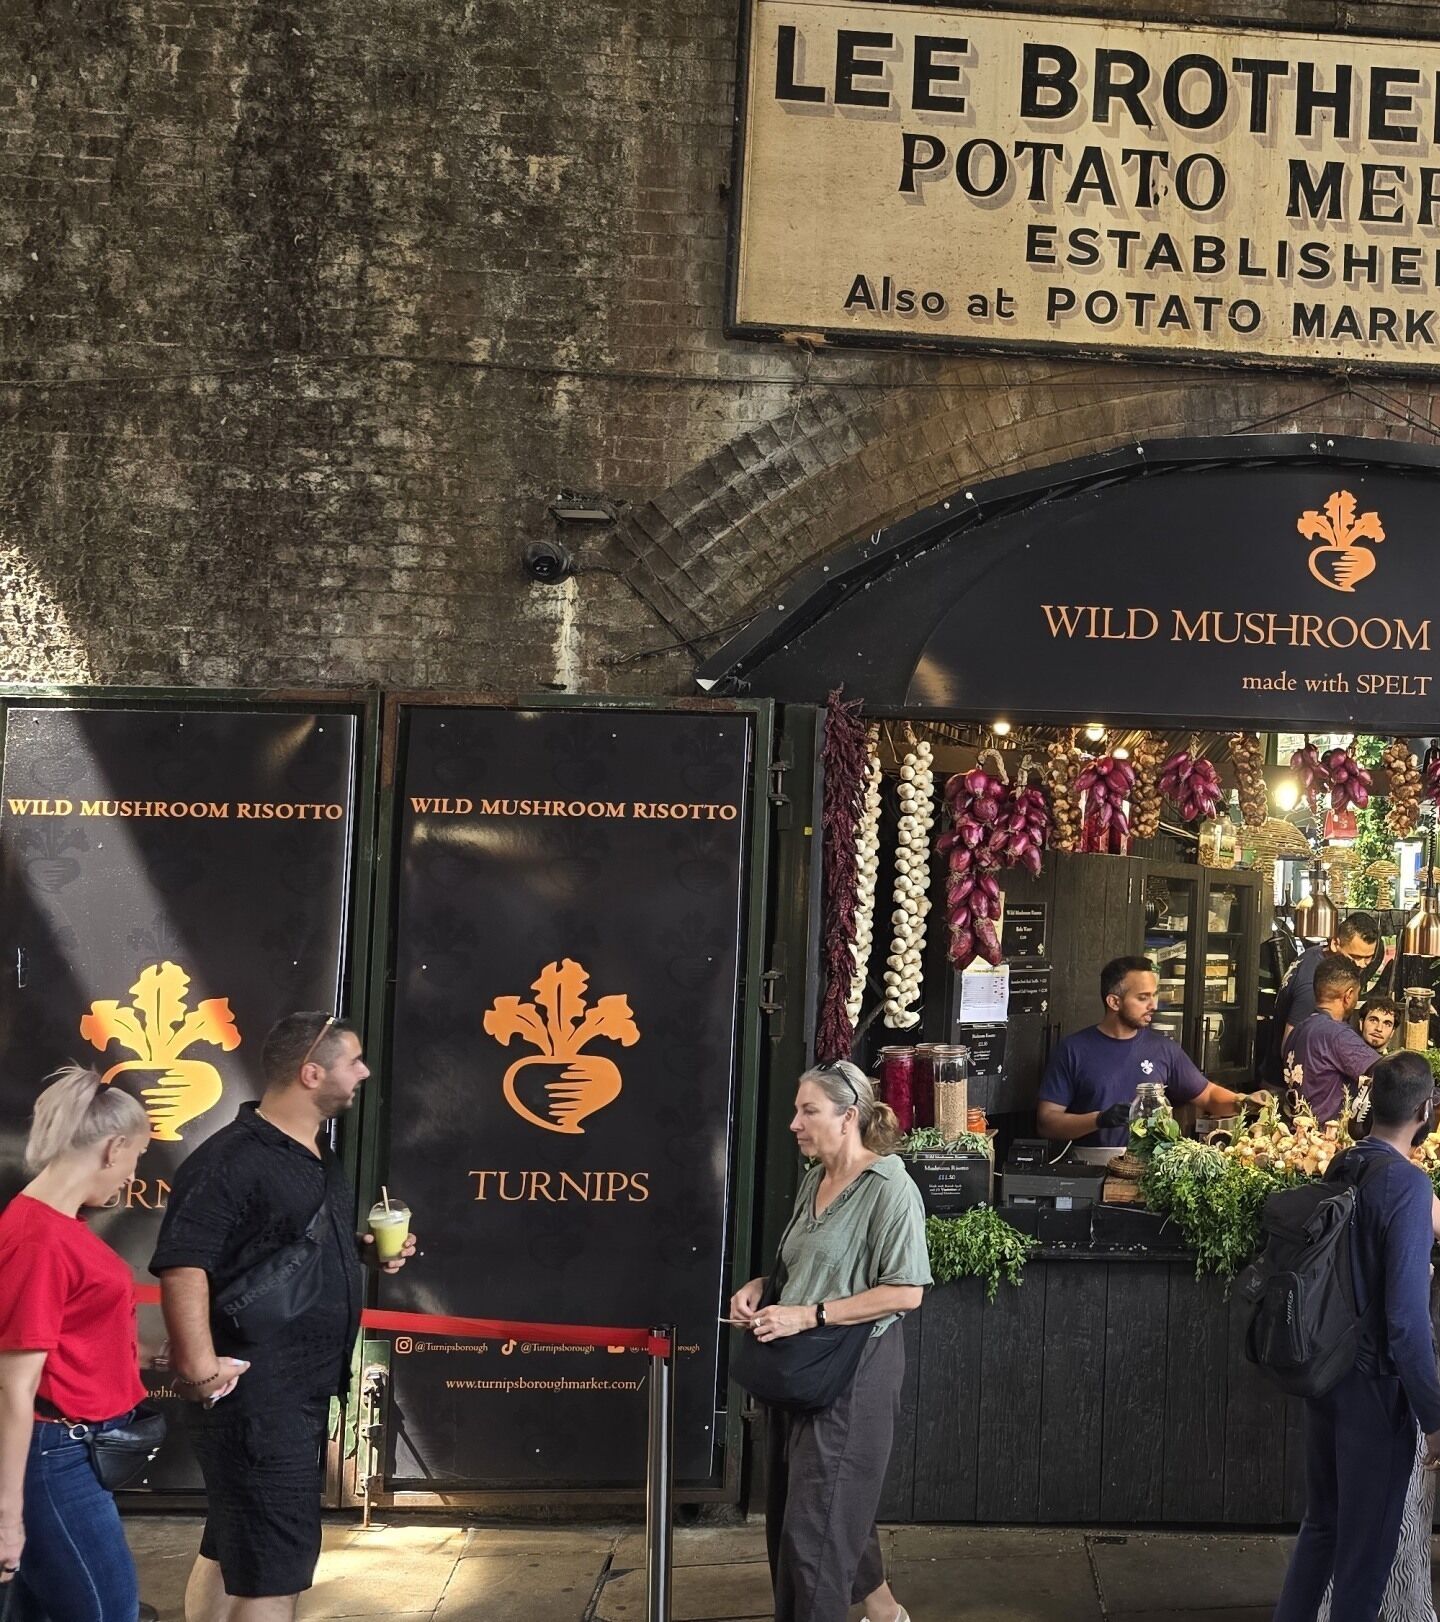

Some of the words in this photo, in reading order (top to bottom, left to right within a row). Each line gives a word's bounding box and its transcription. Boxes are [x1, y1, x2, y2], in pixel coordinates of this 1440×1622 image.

[775, 25, 968, 113] LEE
[899, 133, 1226, 211] POTATO
[844, 274, 945, 314] Also
[968, 288, 1014, 318] at
[1047, 287, 1261, 333] POTATO
[1041, 605, 1159, 641] WILD
[1171, 609, 1431, 652] MUSHROOM
[1242, 671, 1297, 692] made
[1305, 673, 1350, 694] with
[1356, 674, 1433, 697] SPELT
[11, 799, 72, 817] WILD
[80, 800, 229, 819] MUSHROOM
[236, 802, 343, 821] RISOTTO
[410, 797, 474, 814] WILD
[480, 799, 626, 819] MUSHROOM
[632, 801, 738, 821] RISOTTO
[468, 1170, 649, 1203] TURNIPS
[415, 1341, 488, 1354] @Turnipsborough
[521, 1341, 595, 1354] @Turnipsborough
[446, 1375, 645, 1393] www.turnipsboroughmarket.com/
